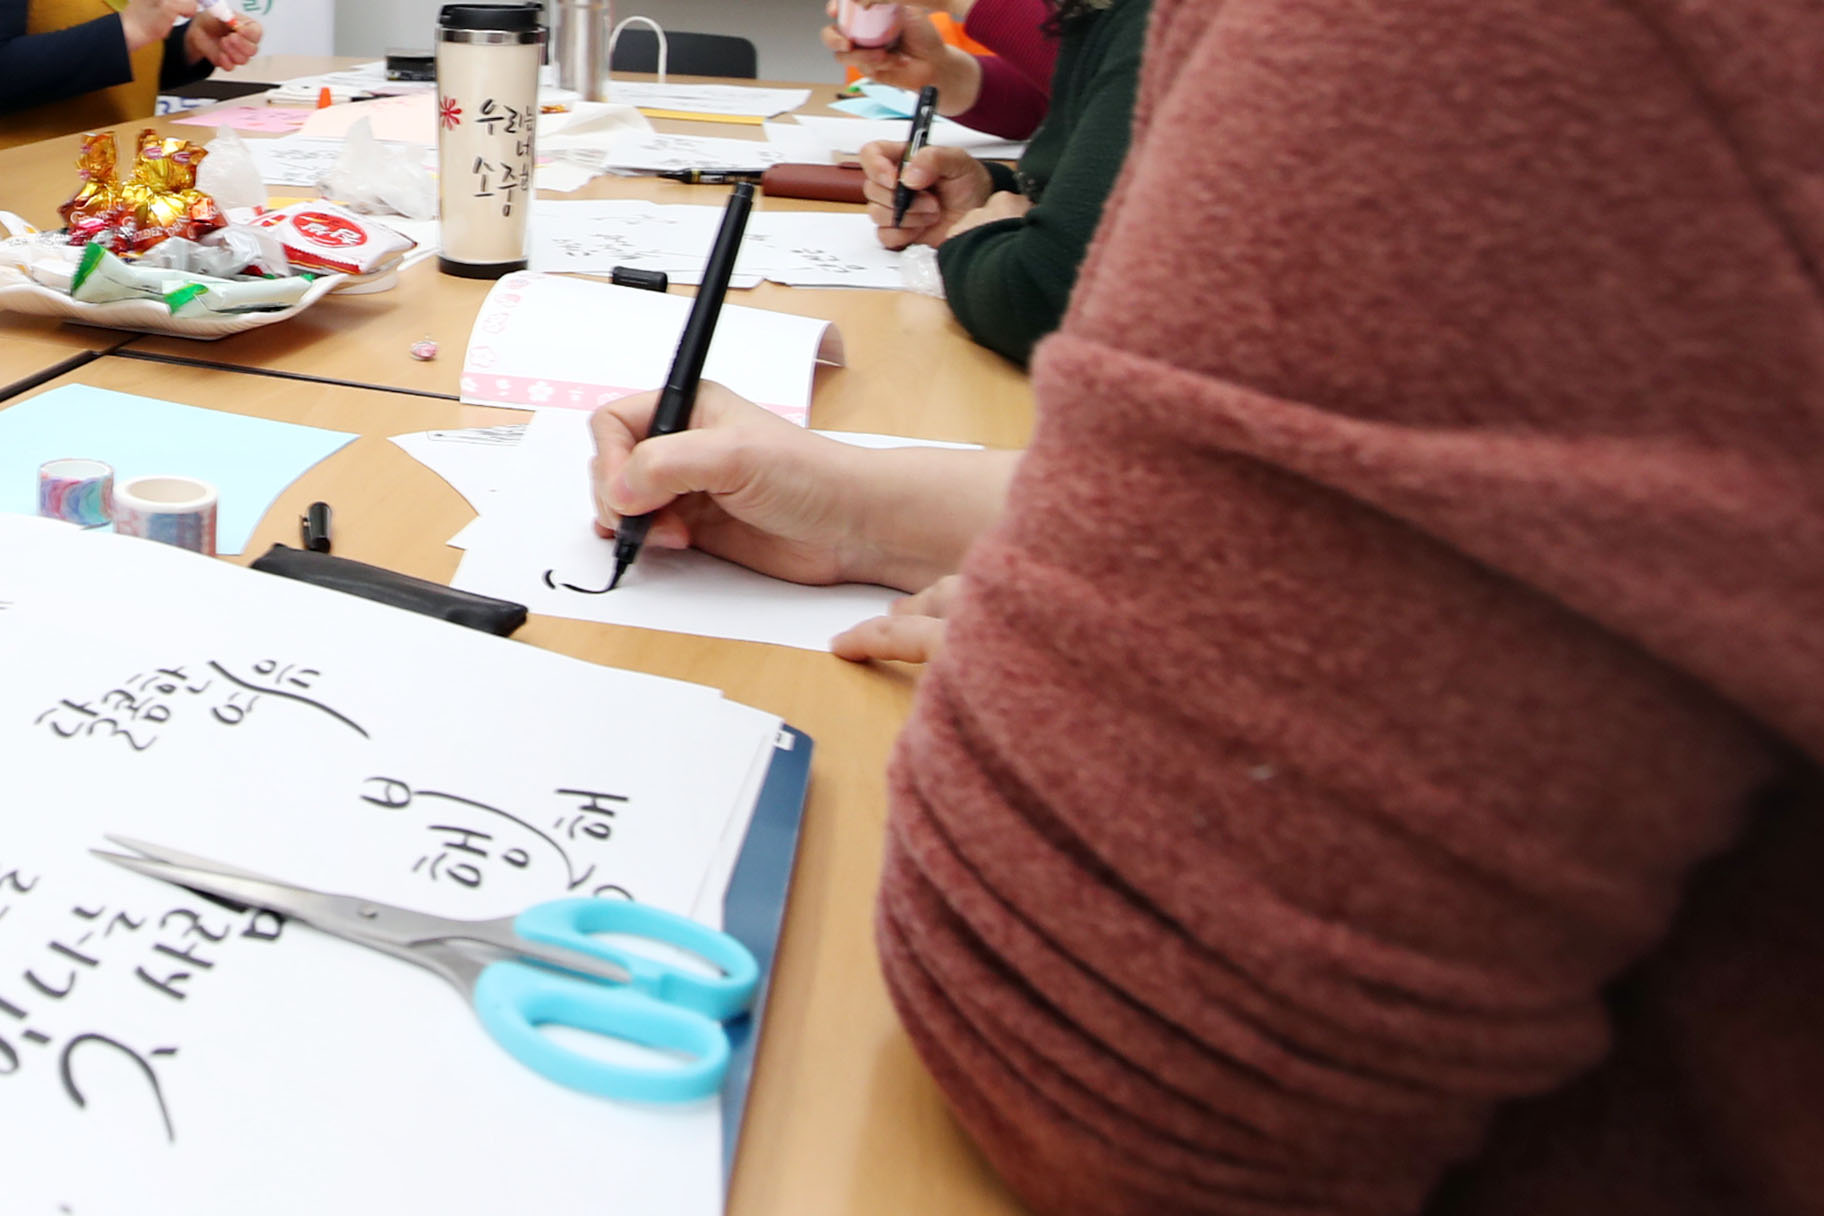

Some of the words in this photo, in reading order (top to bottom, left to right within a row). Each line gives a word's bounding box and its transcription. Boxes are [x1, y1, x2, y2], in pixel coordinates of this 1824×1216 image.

[474, 98, 537, 137] 우리는
[34, 665, 214, 752] 달콤한
[208, 658, 371, 740] 여유
